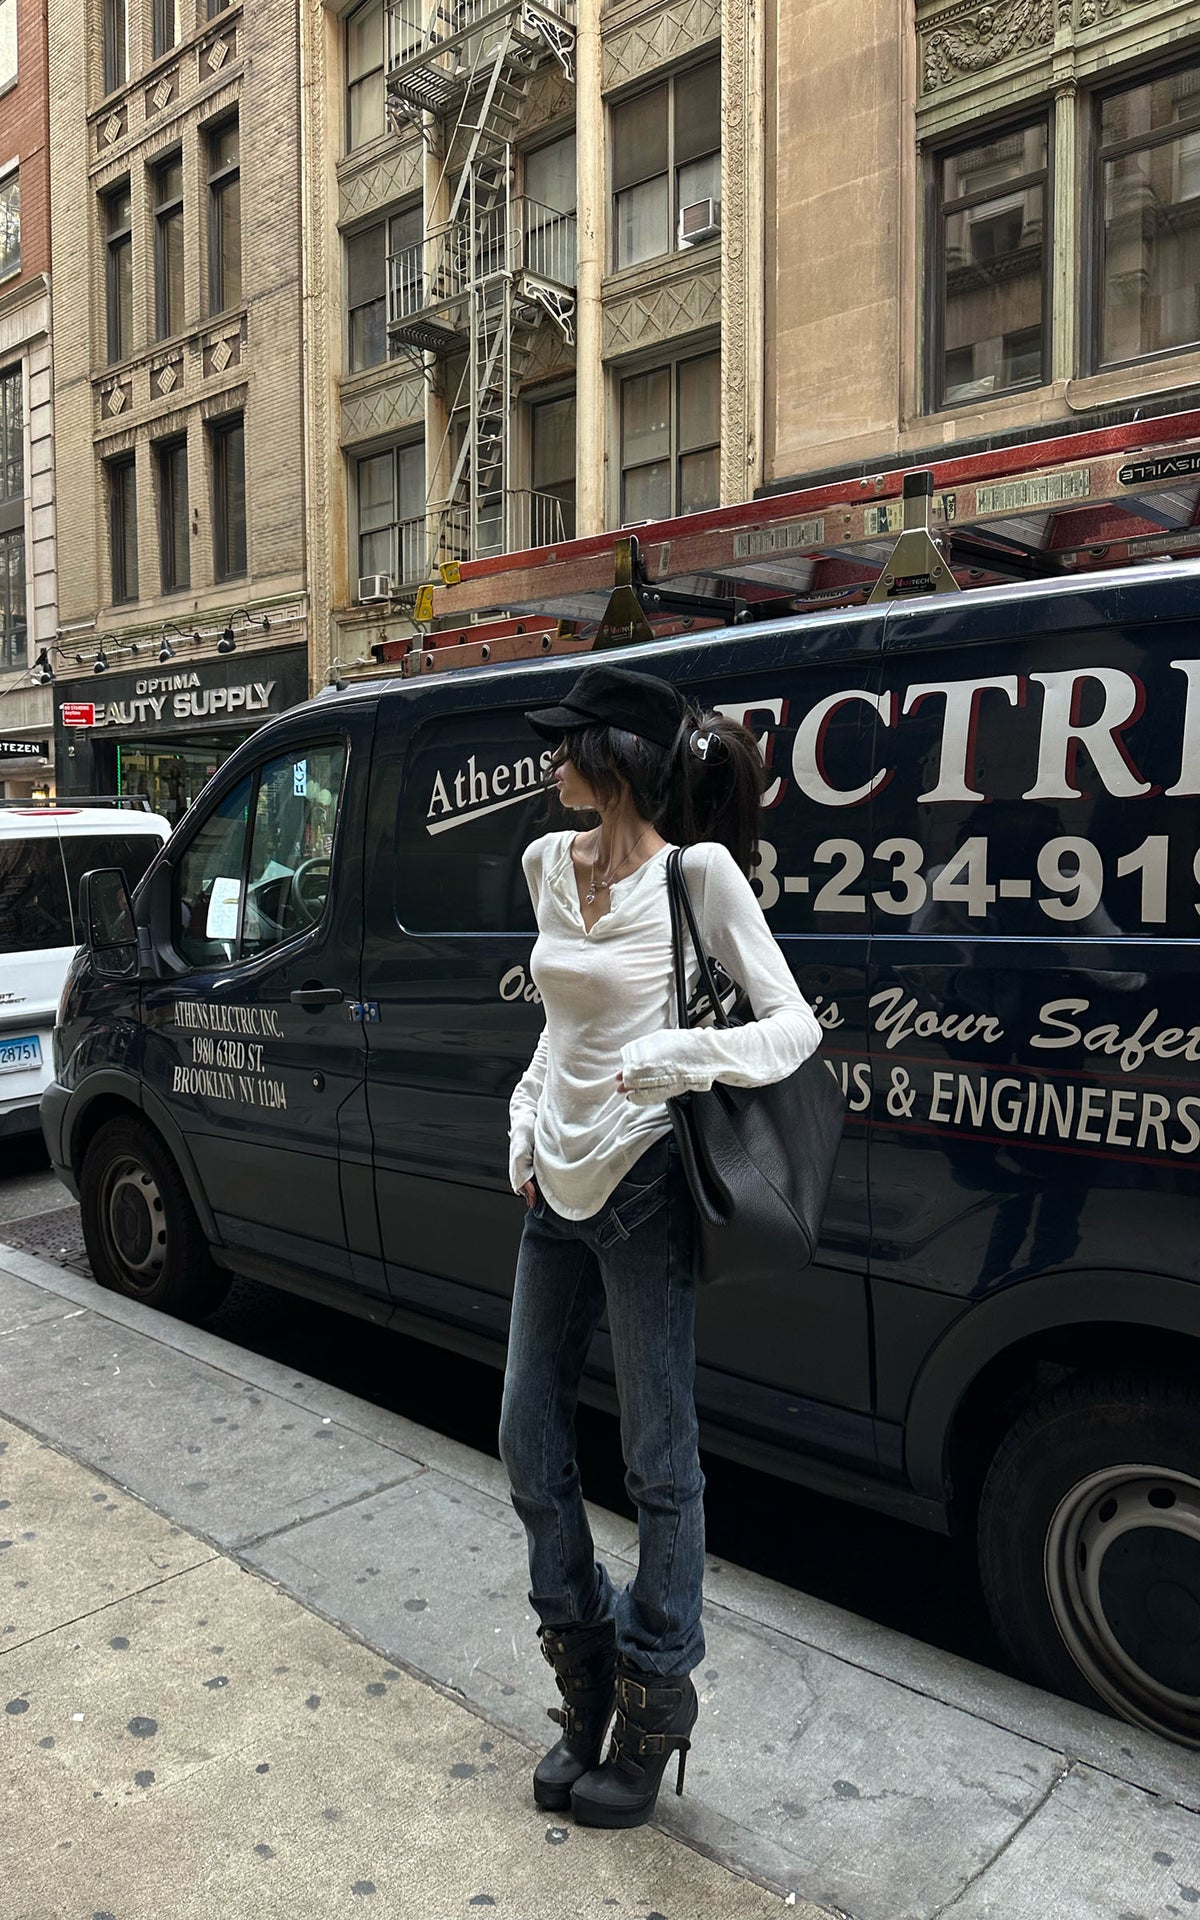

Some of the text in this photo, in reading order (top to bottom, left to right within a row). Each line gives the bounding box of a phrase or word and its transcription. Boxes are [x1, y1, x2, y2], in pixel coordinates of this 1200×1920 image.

[92, 680, 277, 728] EAUTY SUPPLY
[136, 672, 201, 695] OPTIMA
[0, 742, 40, 754] TEZEN
[426, 750, 553, 818] Athens
[749, 835, 1200, 922] 8-234-91
[174, 1001, 285, 1038] ATHENS ELECTRIC INC.
[868, 987, 1004, 1050] Your
[192, 1037, 265, 1073] 1980 63RD ST.
[172, 1066, 287, 1110] BROOKLYN NY 11204
[886, 1066, 917, 1118] &
[928, 1070, 1200, 1154] ENGINEERS
